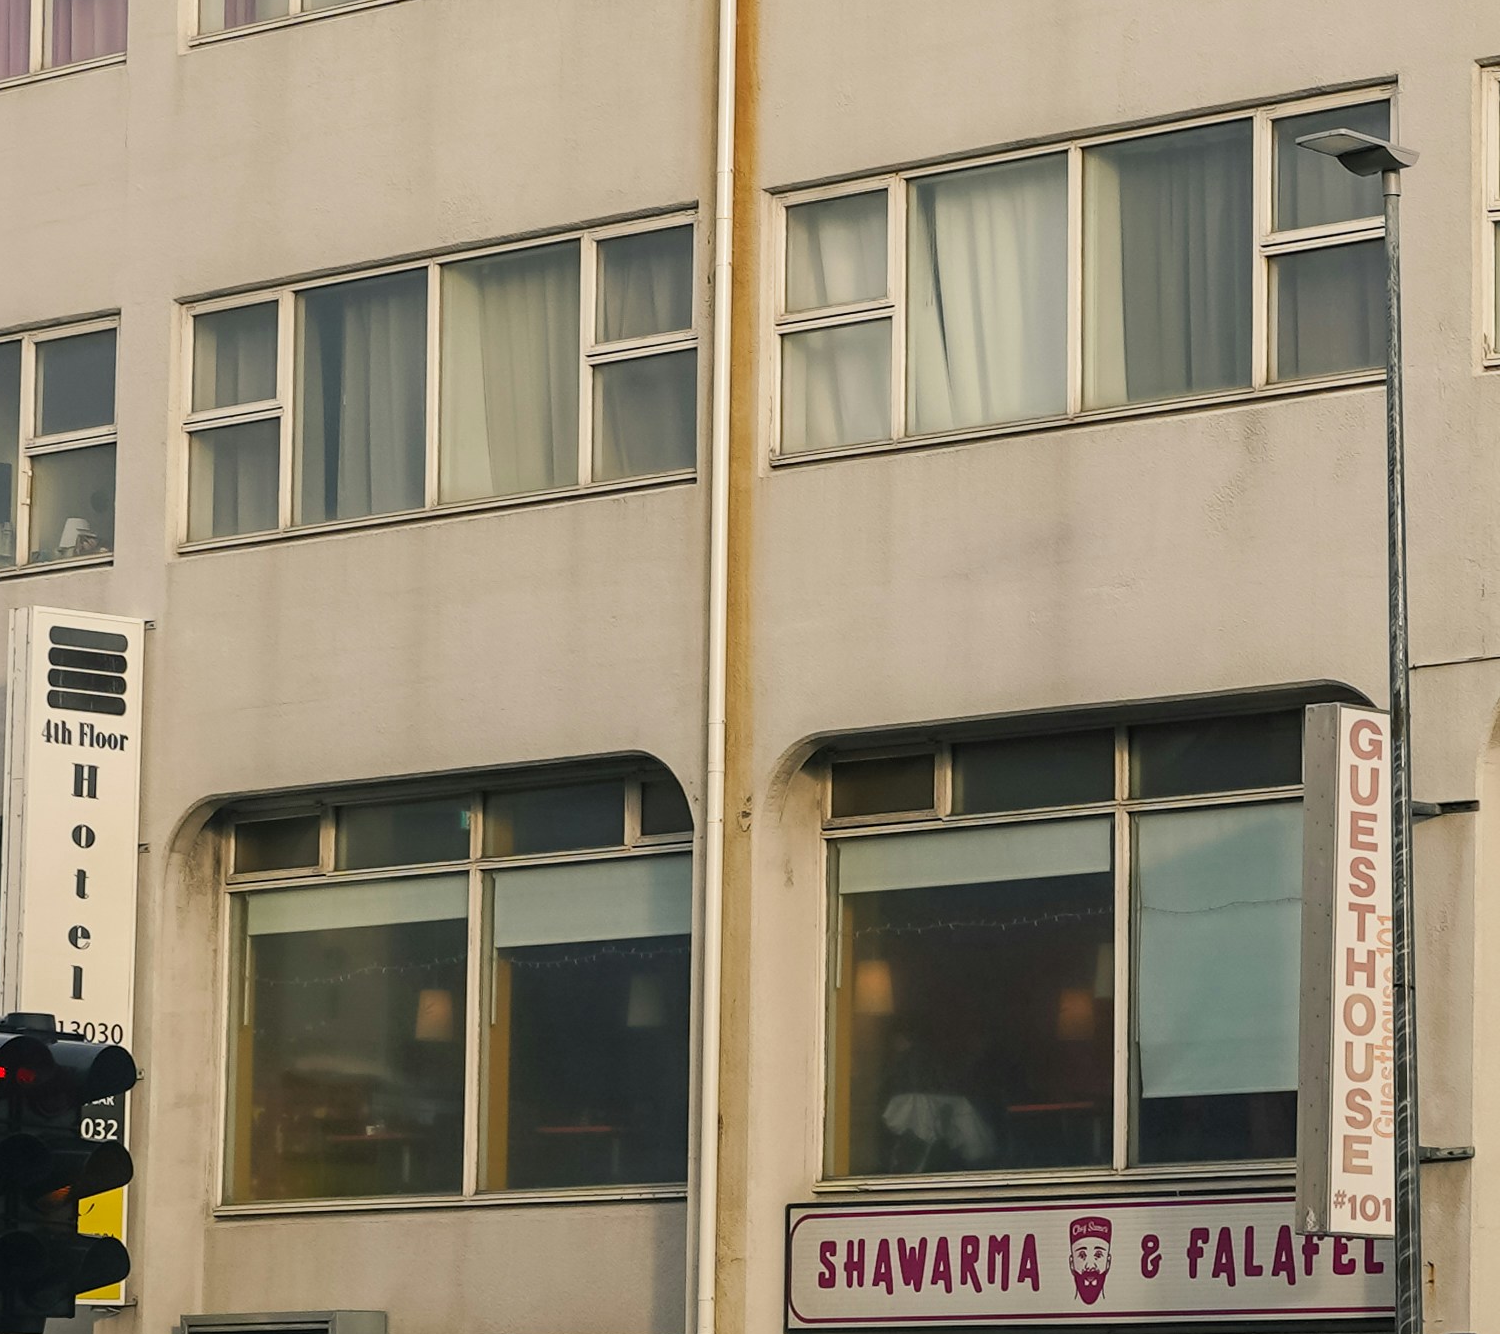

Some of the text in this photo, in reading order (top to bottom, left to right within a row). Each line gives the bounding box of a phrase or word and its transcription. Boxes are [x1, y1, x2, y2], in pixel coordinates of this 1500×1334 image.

[41, 718, 129, 752] 4th Floor
[67, 762, 100, 1001] Hotel
[1342, 718, 1384, 1176] GUESTHOUSE
[1333, 1189, 1393, 1225] #101
[818, 1224, 1385, 1295] SHAWARMA & FALAFEL
